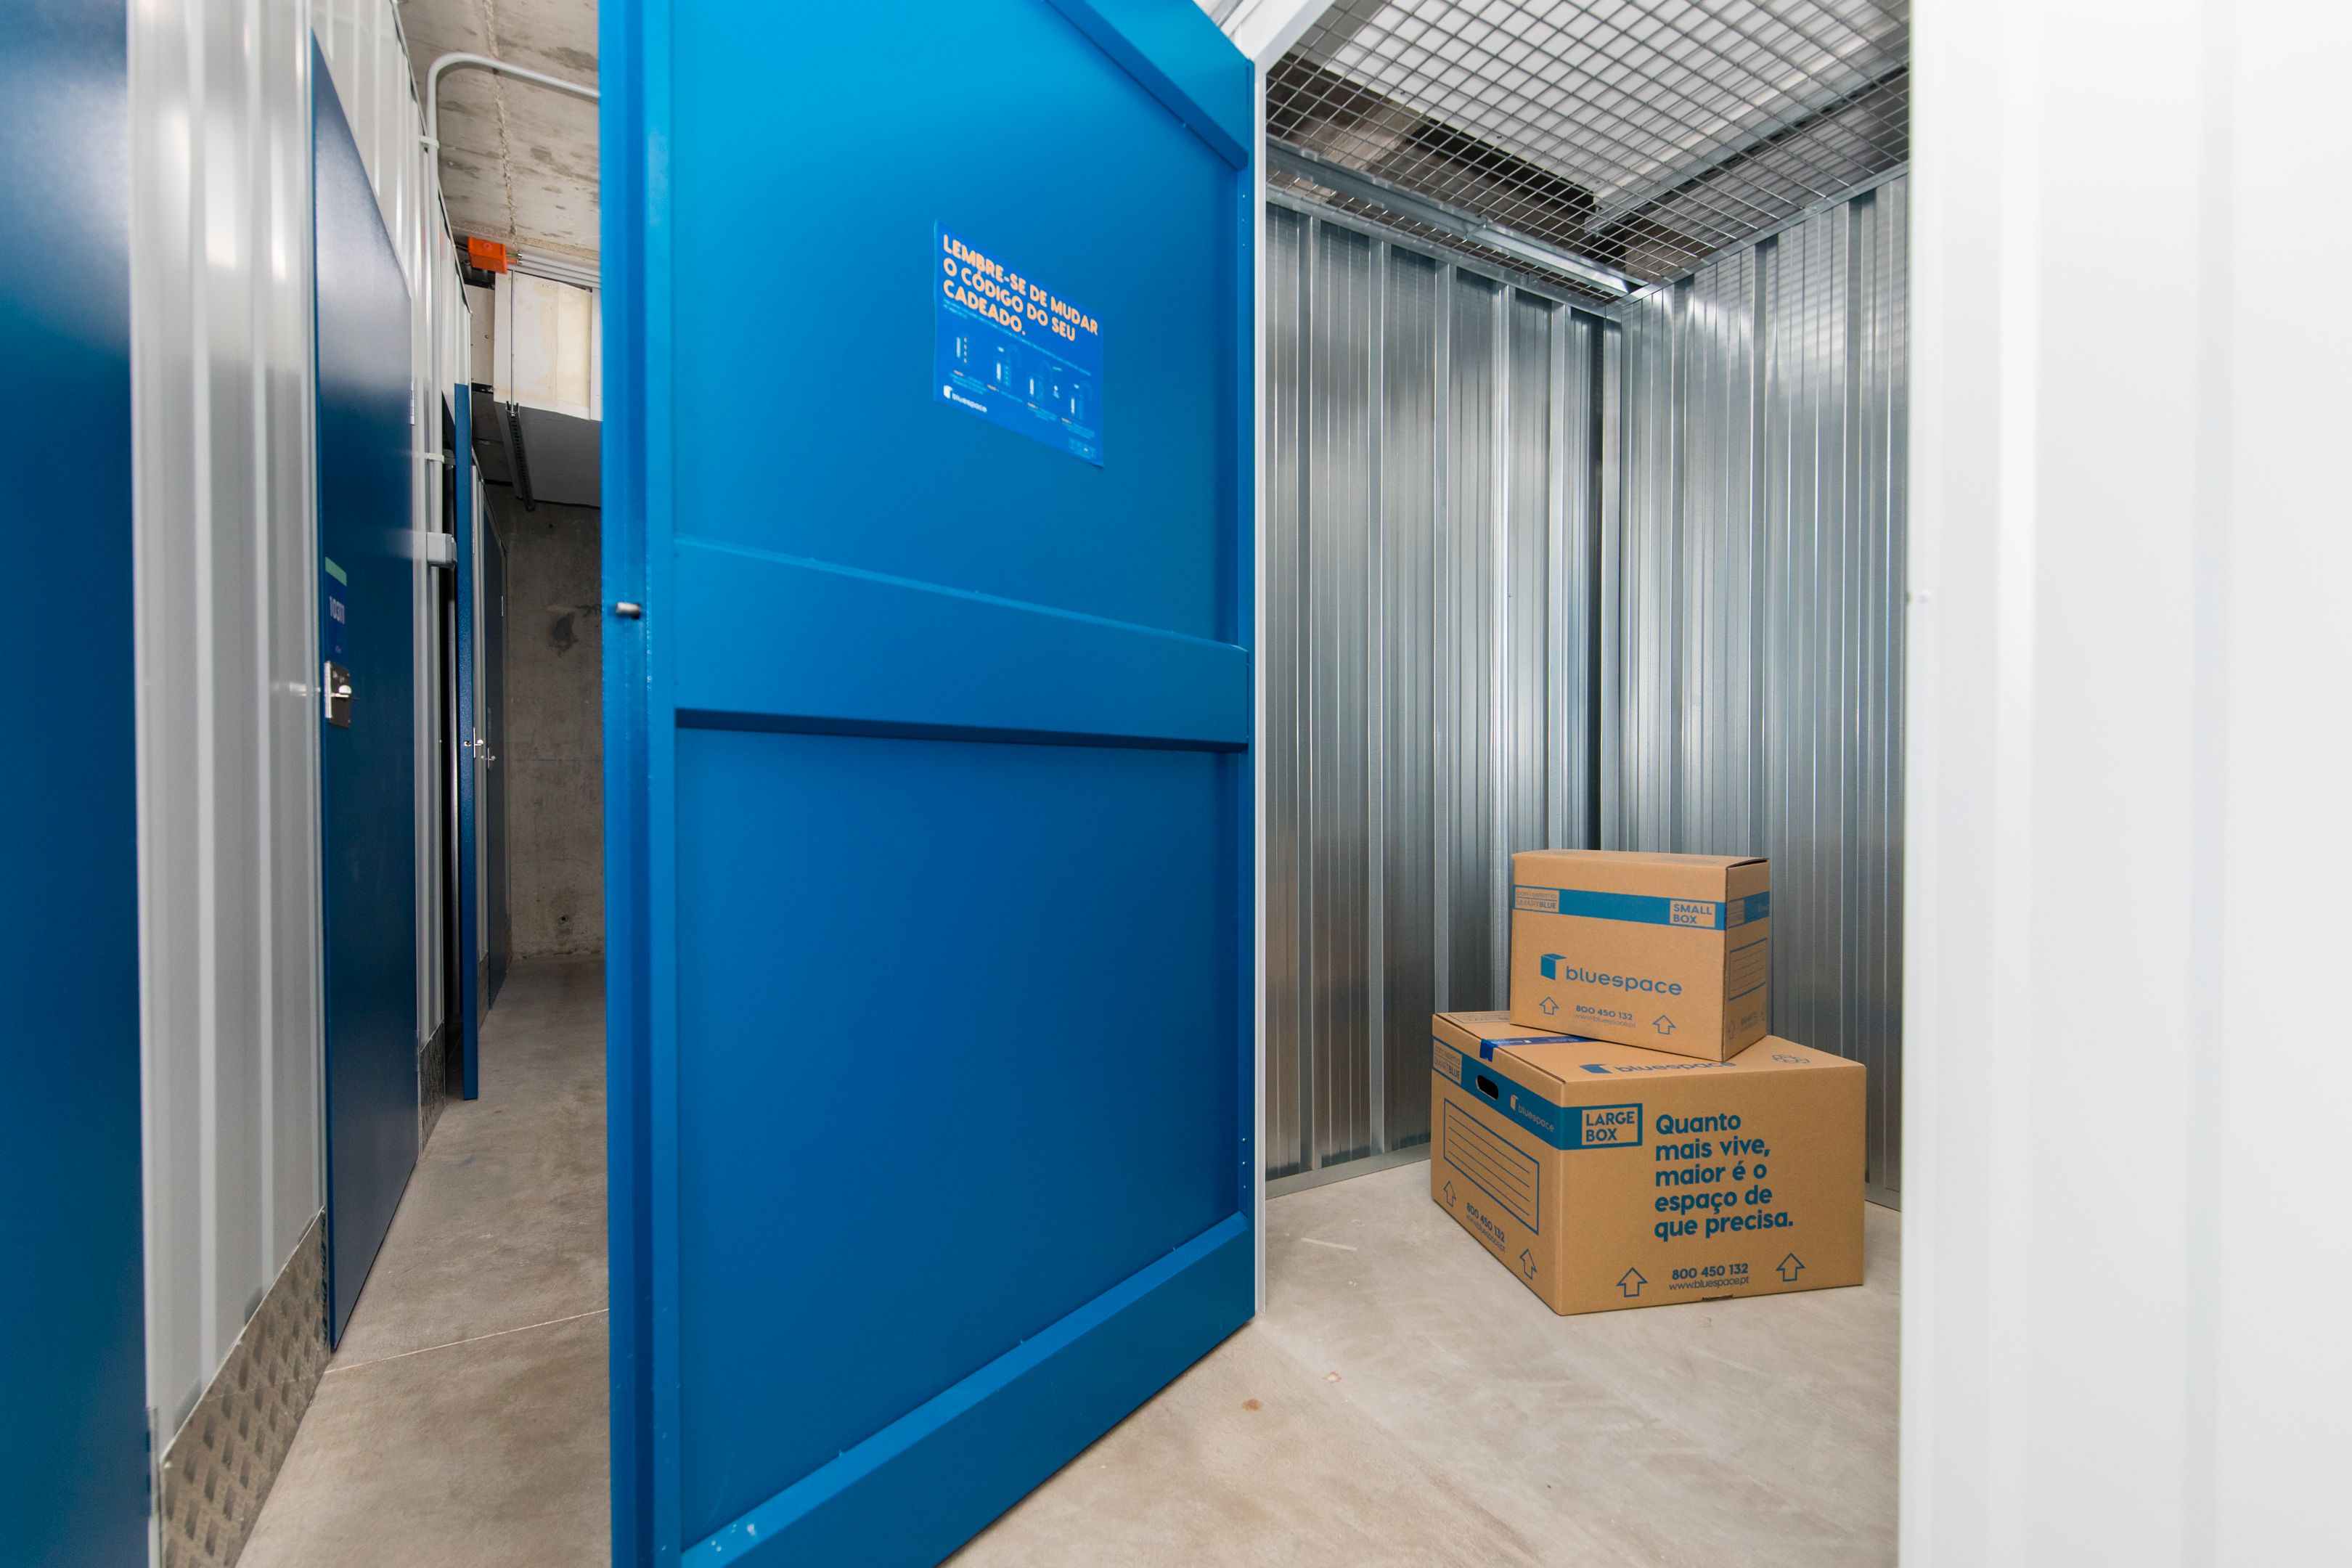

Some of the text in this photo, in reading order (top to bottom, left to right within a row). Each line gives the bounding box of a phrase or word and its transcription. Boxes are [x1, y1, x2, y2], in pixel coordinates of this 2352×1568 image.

[944, 234, 1098, 335] LEMBRE-SE DE MUDAR
[944, 257, 1076, 341] O CÓDIGO DO SEU
[944, 279, 1026, 335] CADEADO.
[1516, 899, 1556, 910] SMARTBLUE
[1673, 903, 1712, 915] SMALL
[1673, 914, 1697, 924] BOX
[1565, 965, 1683, 996] bluespace
[1575, 1005, 1633, 1021] 800 450 132
[1434, 1057, 1461, 1079] SMARTBLUE
[1614, 1061, 1736, 1073] bluespace
[1518, 1103, 1555, 1132] bluespace
[1585, 1111, 1635, 1127] LARGE
[1656, 1113, 1741, 1135] Quanto
[1585, 1127, 1618, 1143] BOX
[1656, 1135, 1771, 1161] mais vive,
[1655, 1160, 1767, 1187] maior é o
[1654, 1185, 1773, 1215] espaço de
[1466, 1202, 1505, 1243] 800 450 132
[1654, 1209, 1794, 1242] que precisa.
[1672, 1263, 1749, 1280] 800 450 132
[1668, 1276, 1749, 1291] www.bluespace.pt
